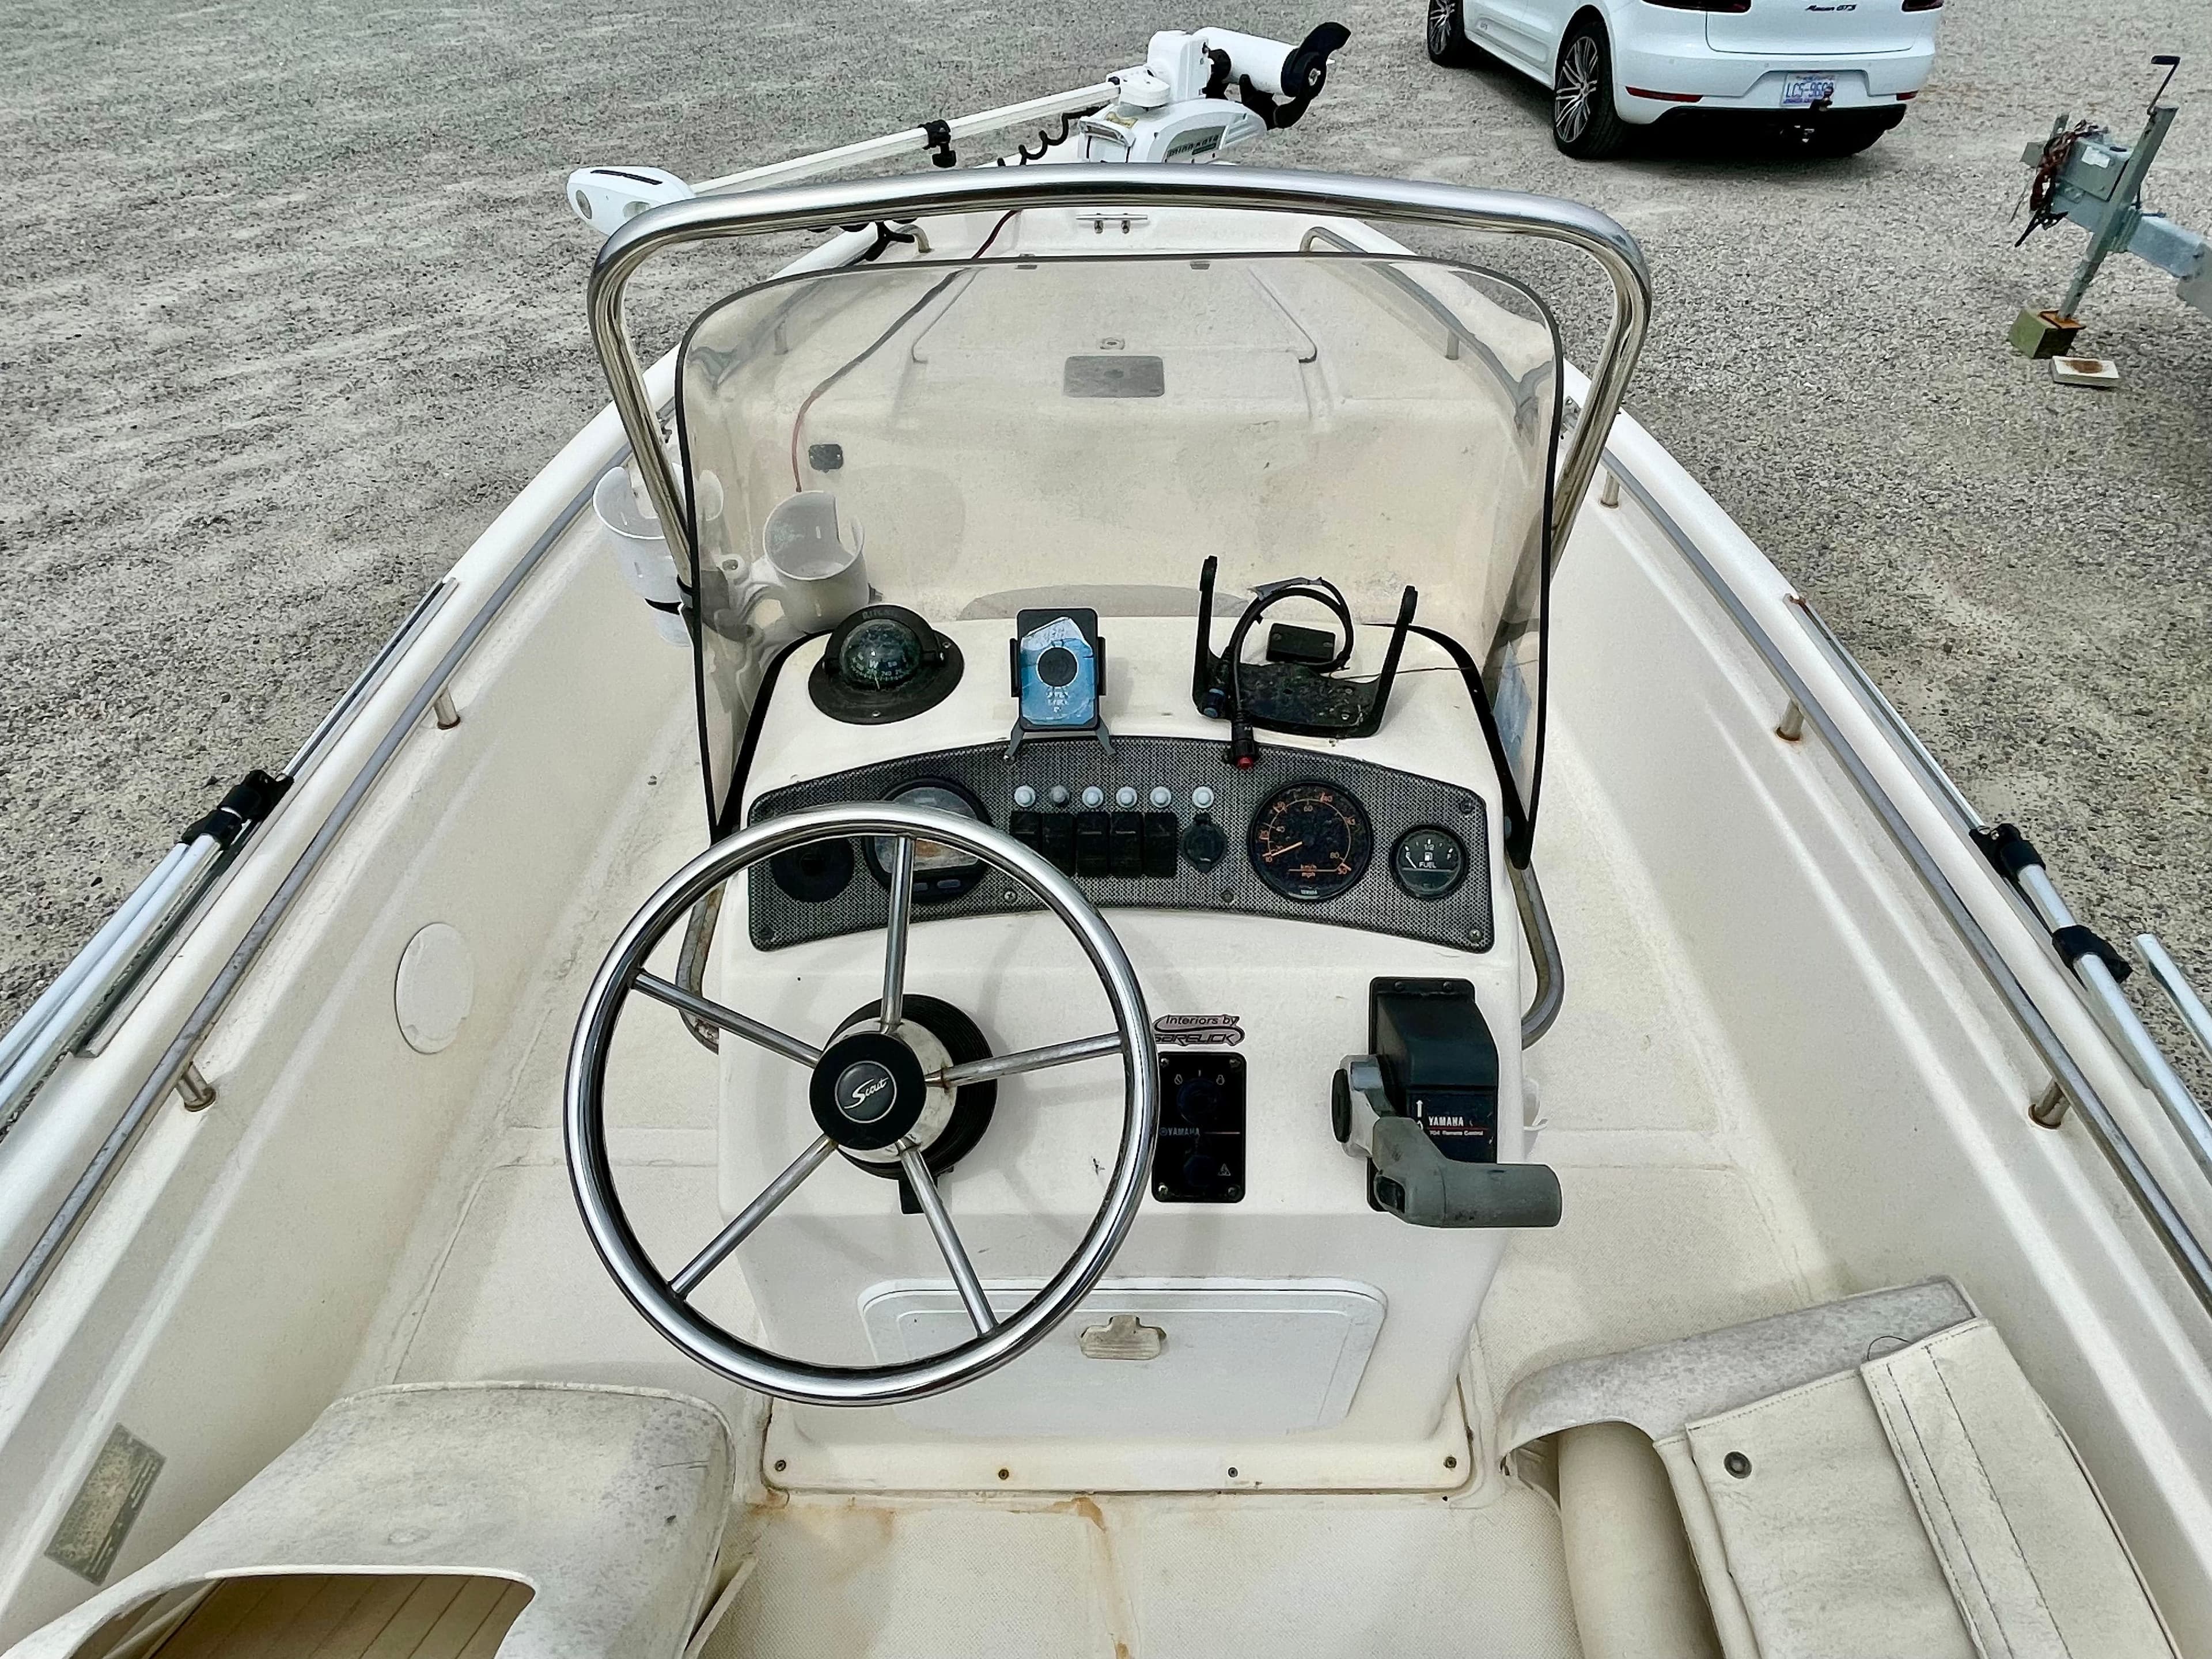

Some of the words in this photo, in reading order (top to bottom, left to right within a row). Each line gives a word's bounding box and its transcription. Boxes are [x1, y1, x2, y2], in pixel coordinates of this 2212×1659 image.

[1165, 1014, 1218, 1025] Interiors
[1222, 1014, 1237, 1027] by
[844, 1077, 889, 1109] Scout
[1429, 1116, 1464, 1127] YAMAHA
[1168, 1127, 1200, 1136] YAMAHA
